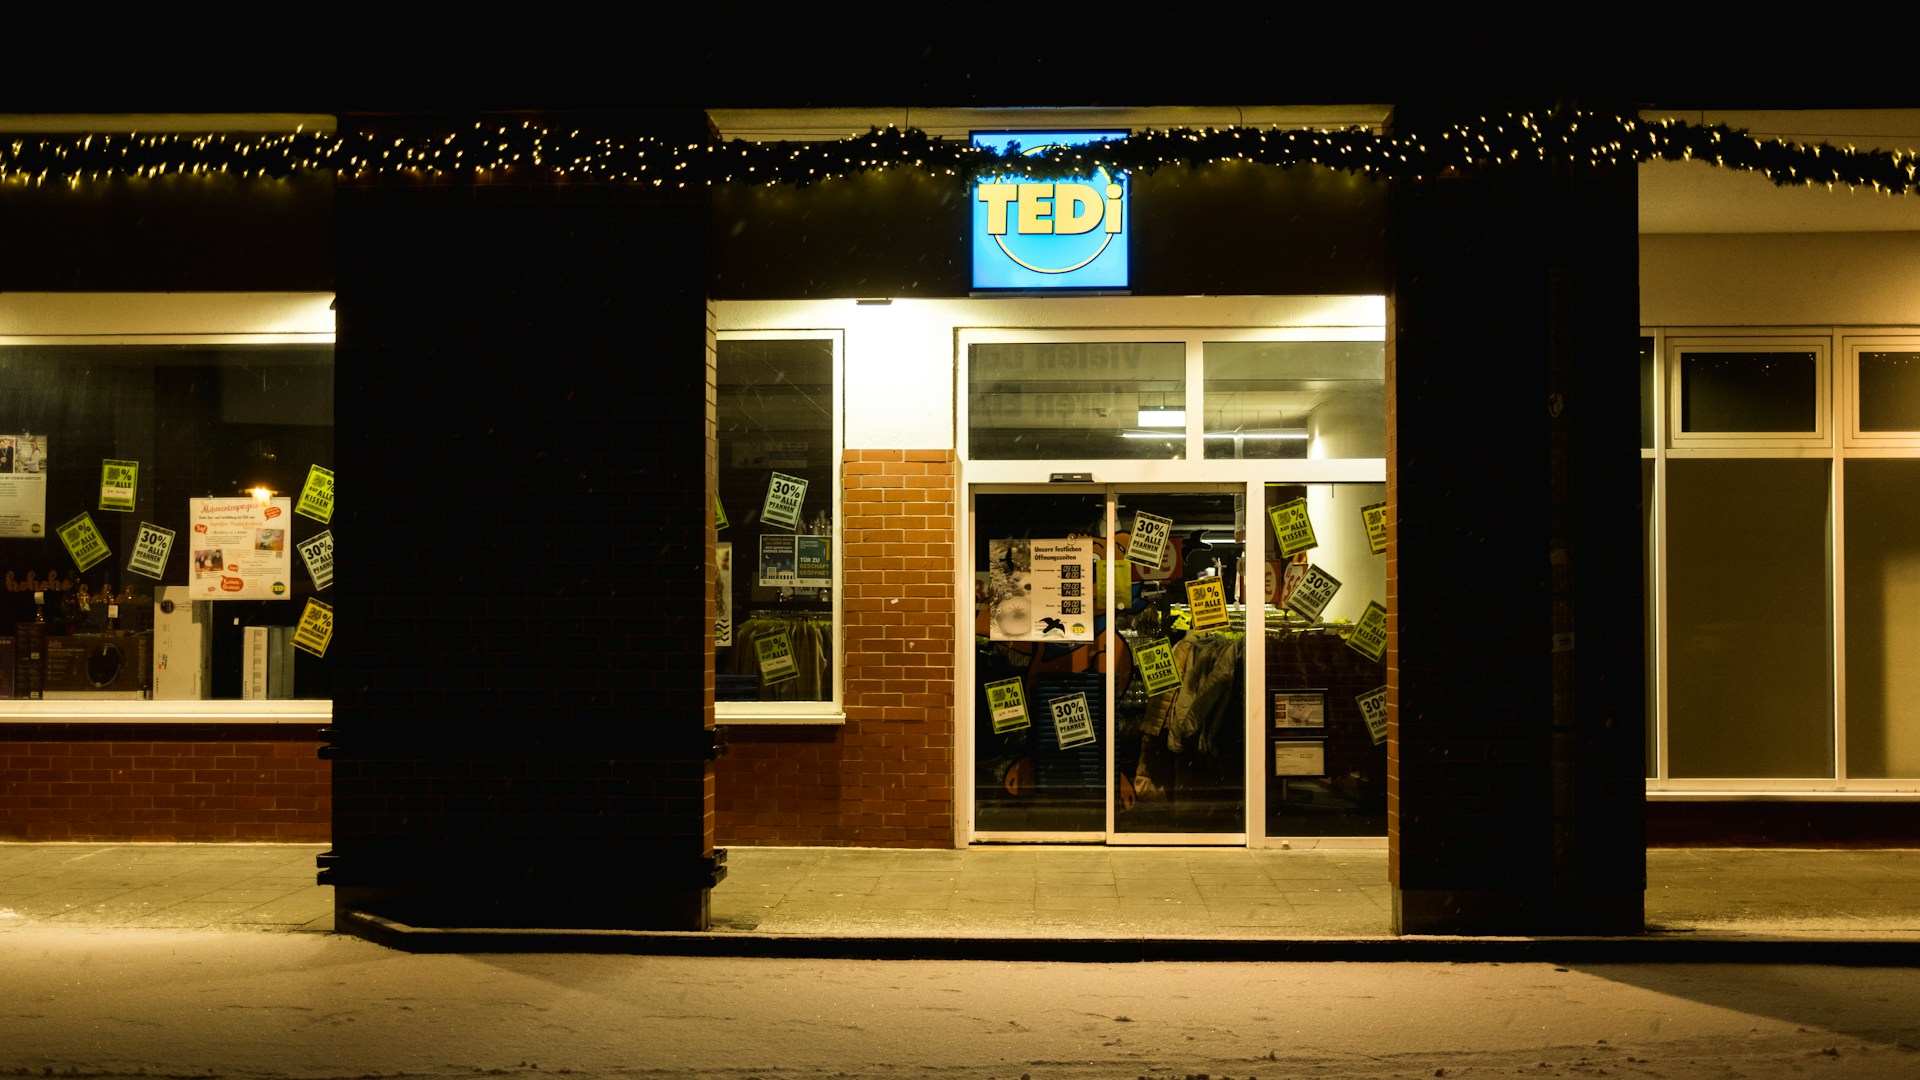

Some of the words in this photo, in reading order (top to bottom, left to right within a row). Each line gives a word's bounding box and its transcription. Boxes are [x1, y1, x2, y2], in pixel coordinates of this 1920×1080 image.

[977, 183, 1123, 236] TEDi
[115, 481, 132, 489] ALLE
[773, 481, 800, 499] 30%
[304, 493, 329, 508] KISSEN
[780, 496, 798, 507] ALLE
[769, 501, 795, 513] PFANNEN
[1136, 519, 1164, 539] 30%
[1289, 520, 1308, 532] ALLE
[80, 532, 97, 546] ALLE
[140, 530, 167, 549] 30%
[1145, 534, 1162, 546] ALLE
[1281, 529, 1308, 543] KISSEN
[75, 539, 99, 558] KISSEN
[148, 546, 164, 557] ALLE
[304, 539, 333, 560] 30%
[1133, 540, 1159, 552] PFANNEN
[136, 550, 161, 562] PFANNEN
[1034, 554, 1077, 562] Öffnungszeiten
[1306, 572, 1332, 597] 30%
[1297, 590, 1320, 609] PFANNEN
[1302, 583, 1312, 592] AUF
[1309, 589, 1327, 604] ALLE
[1204, 598, 1222, 608] ALLE
[312, 623, 329, 635] ALLE
[1363, 620, 1373, 629] AUF
[1358, 627, 1381, 646] KISSEN
[771, 648, 789, 659] ALLE
[1155, 659, 1172, 670] ALLE
[1146, 668, 1173, 680] KISSEN
[1004, 699, 1021, 708] ALLE
[1055, 701, 1084, 718] 30%
[1068, 714, 1086, 723] ALLE
[1378, 710, 1387, 718] AL
[1059, 723, 1086, 733] PFANNEN
